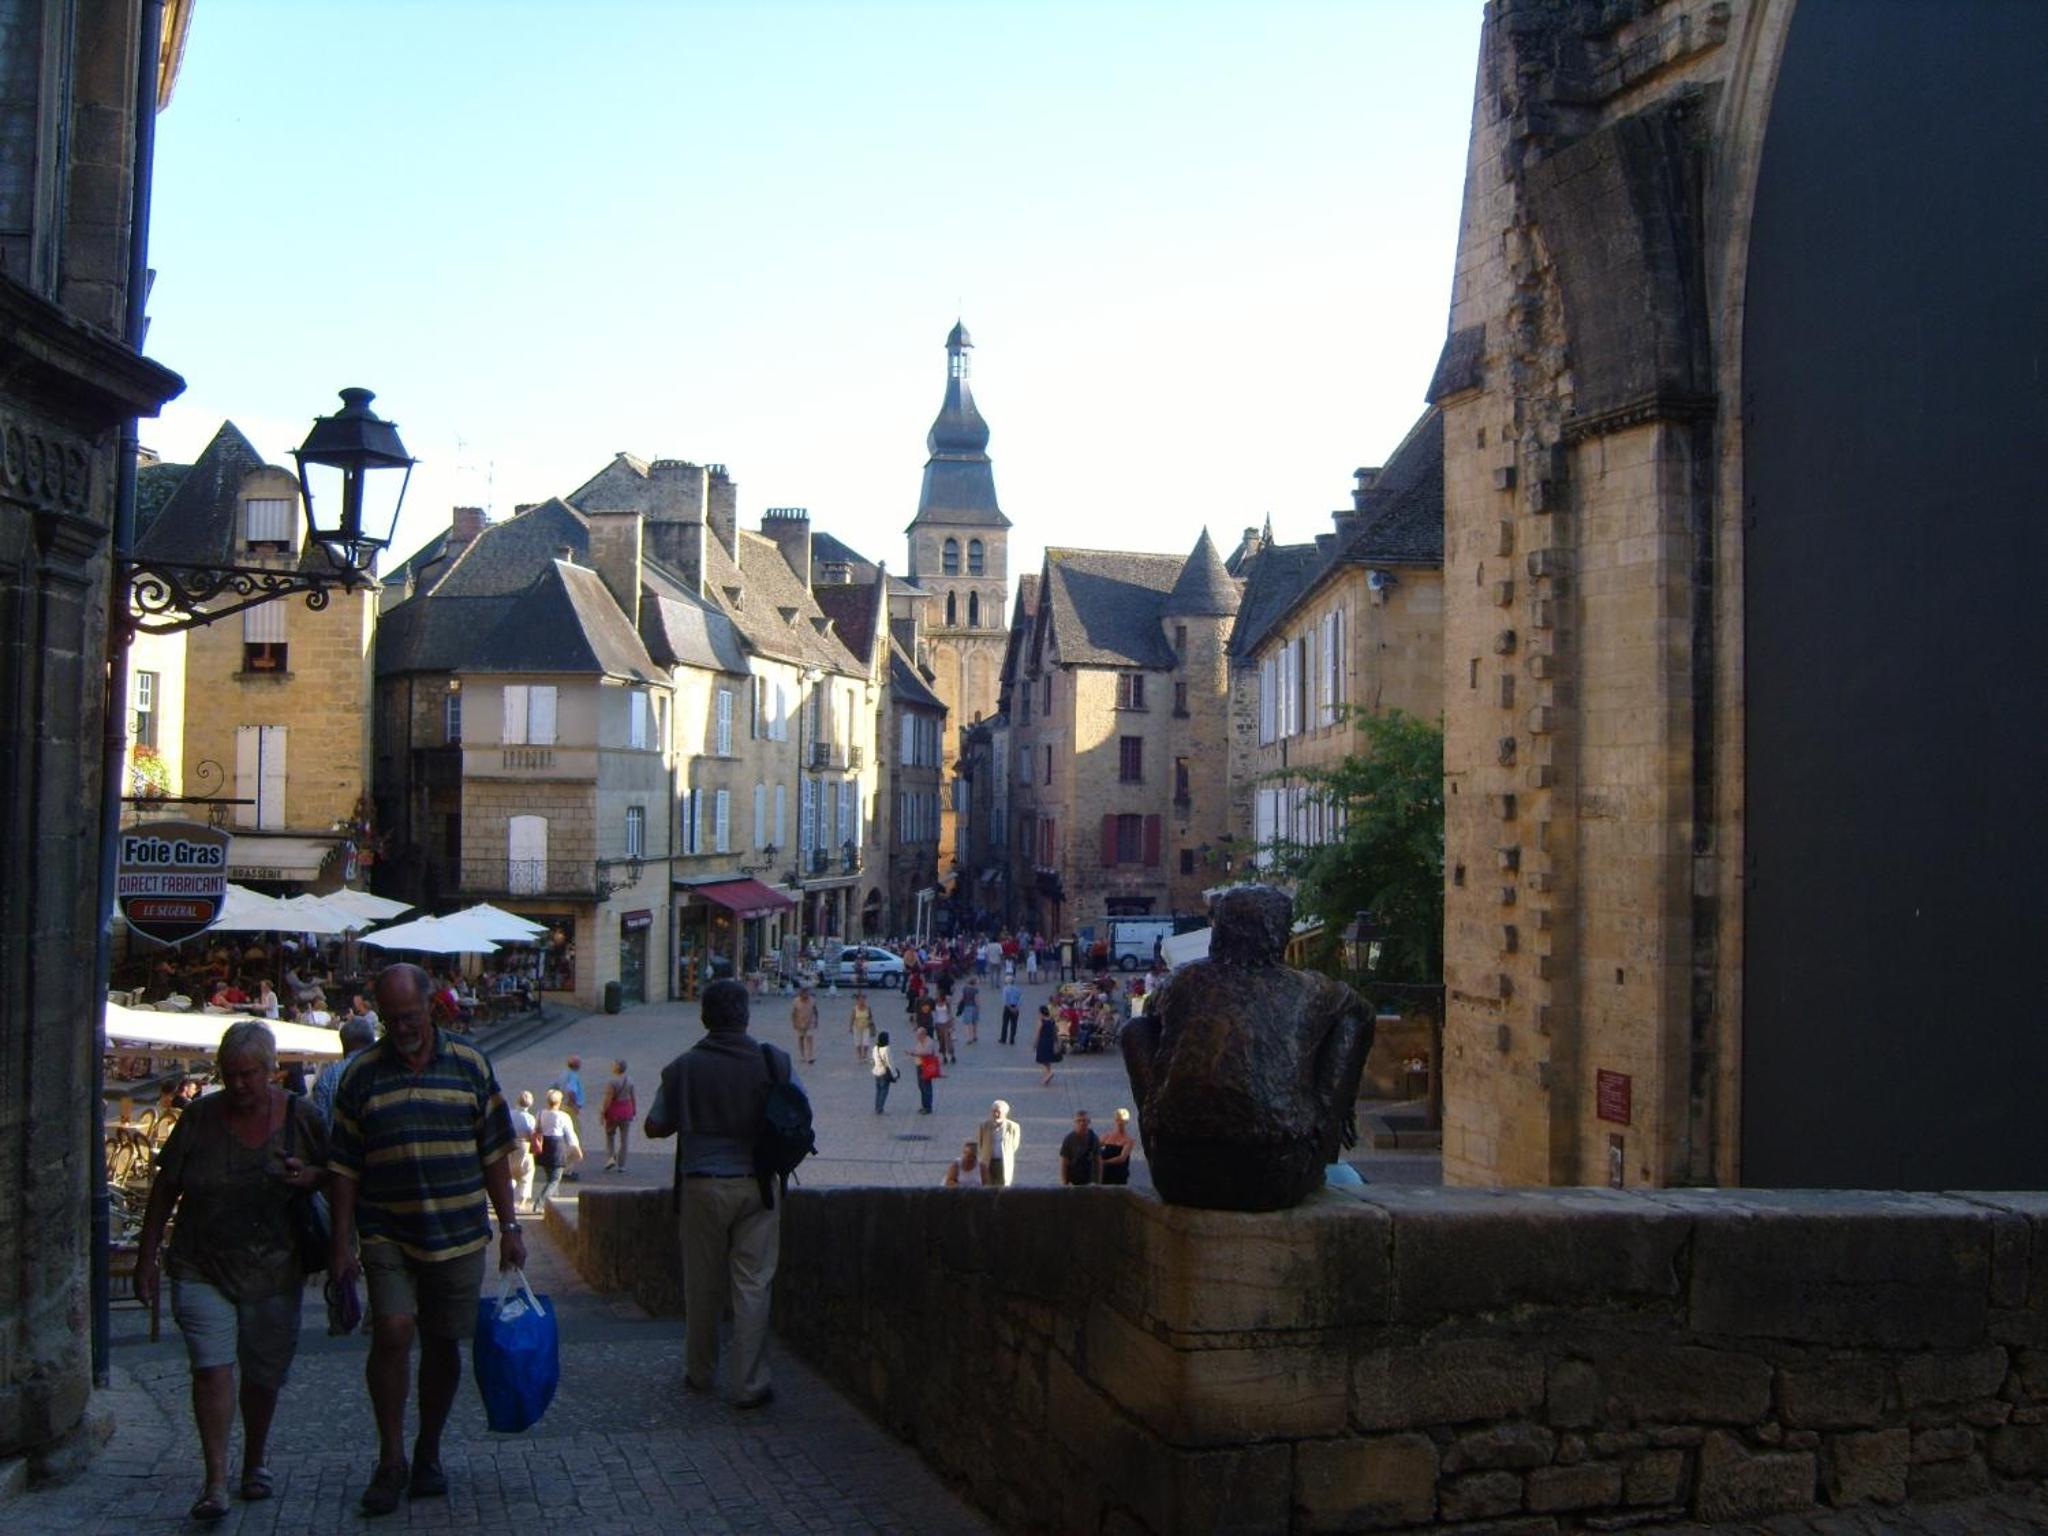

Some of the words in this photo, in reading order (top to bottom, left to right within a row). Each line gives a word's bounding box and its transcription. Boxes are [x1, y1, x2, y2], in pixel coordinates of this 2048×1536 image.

[125, 838, 171, 863] Foie
[175, 842, 221, 865] Gras
[119, 875, 158, 893] DIRECT
[162, 875, 225, 893] FABRICANT
